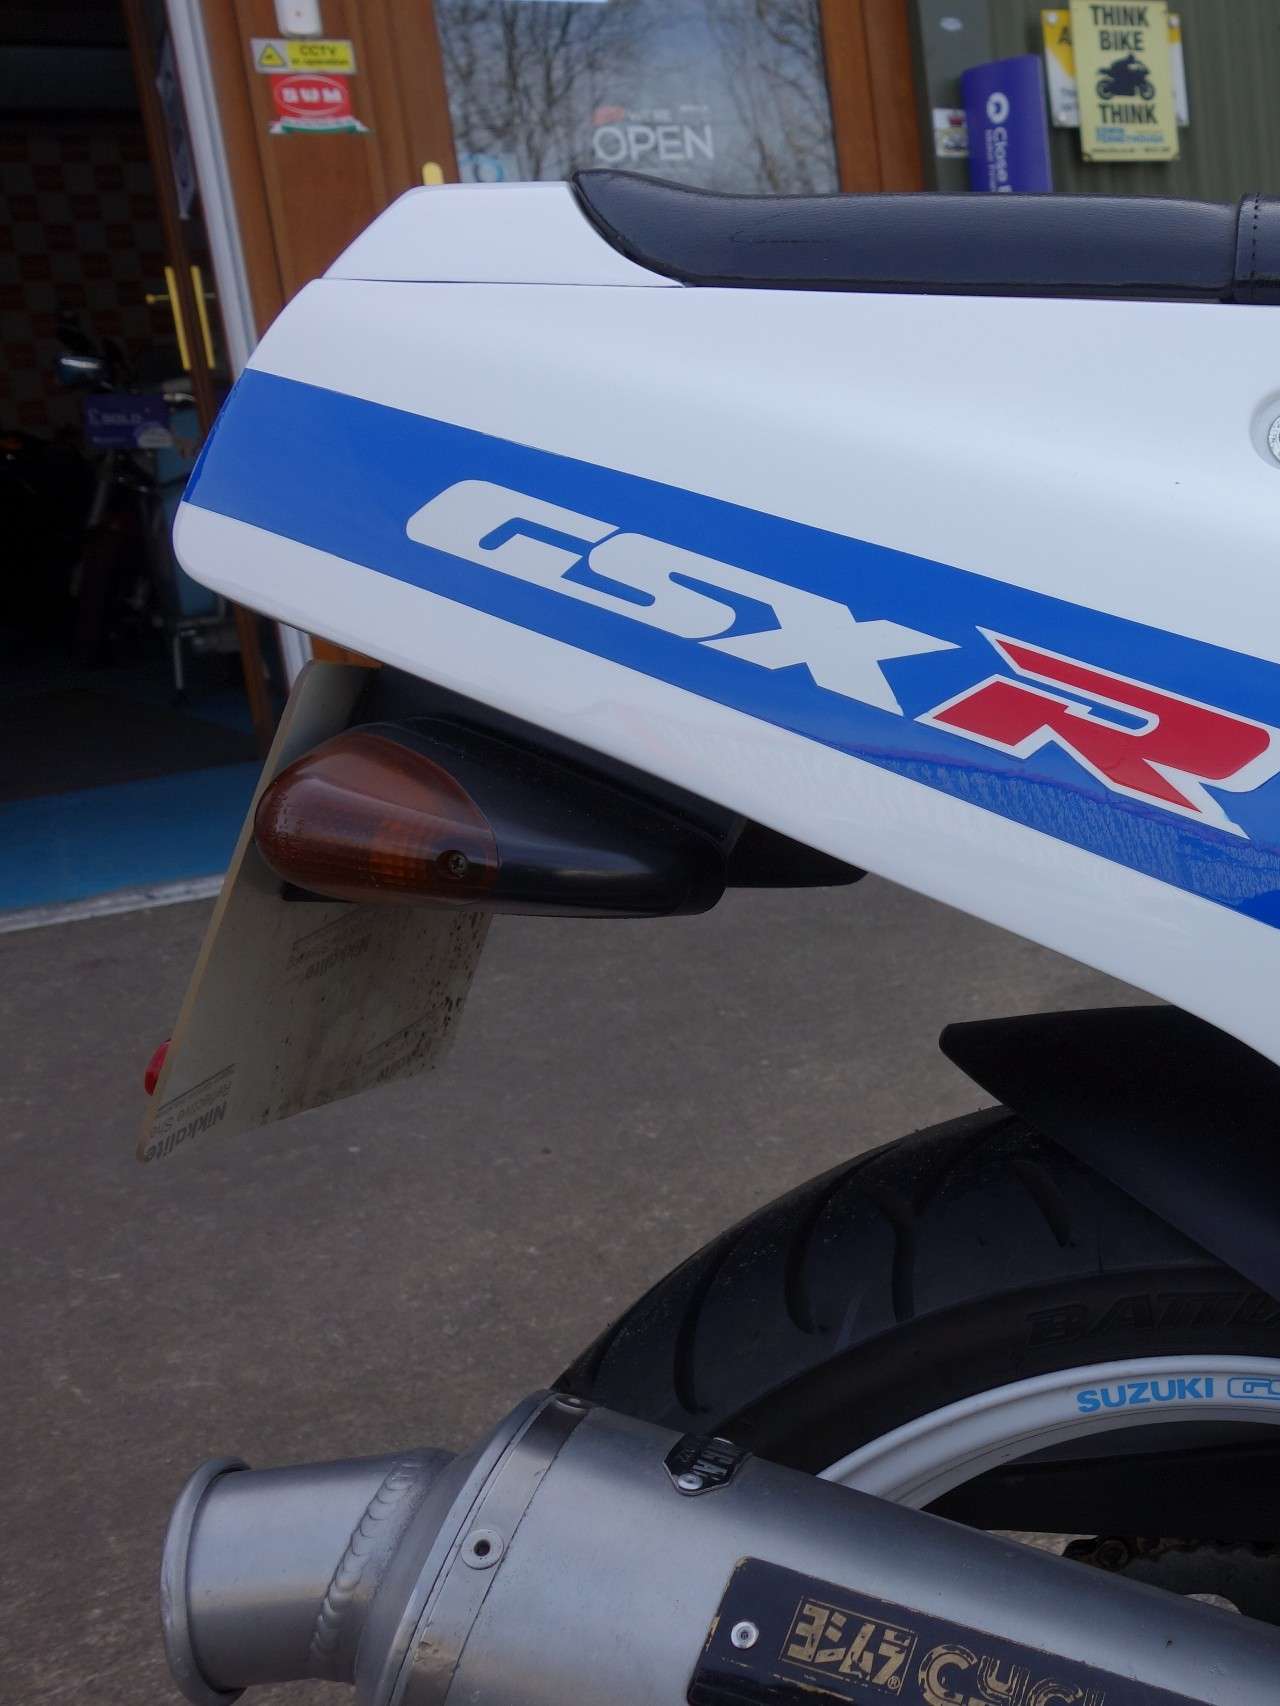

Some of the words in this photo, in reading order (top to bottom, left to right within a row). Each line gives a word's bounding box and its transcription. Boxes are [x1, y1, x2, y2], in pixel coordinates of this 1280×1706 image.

[1091, 5, 1148, 26] THINK
[1099, 30, 1146, 51] BIKE
[1099, 104, 1157, 125] THINK
[593, 124, 715, 162] OPEN
[1076, 1377, 1214, 1413] SUZUKI
